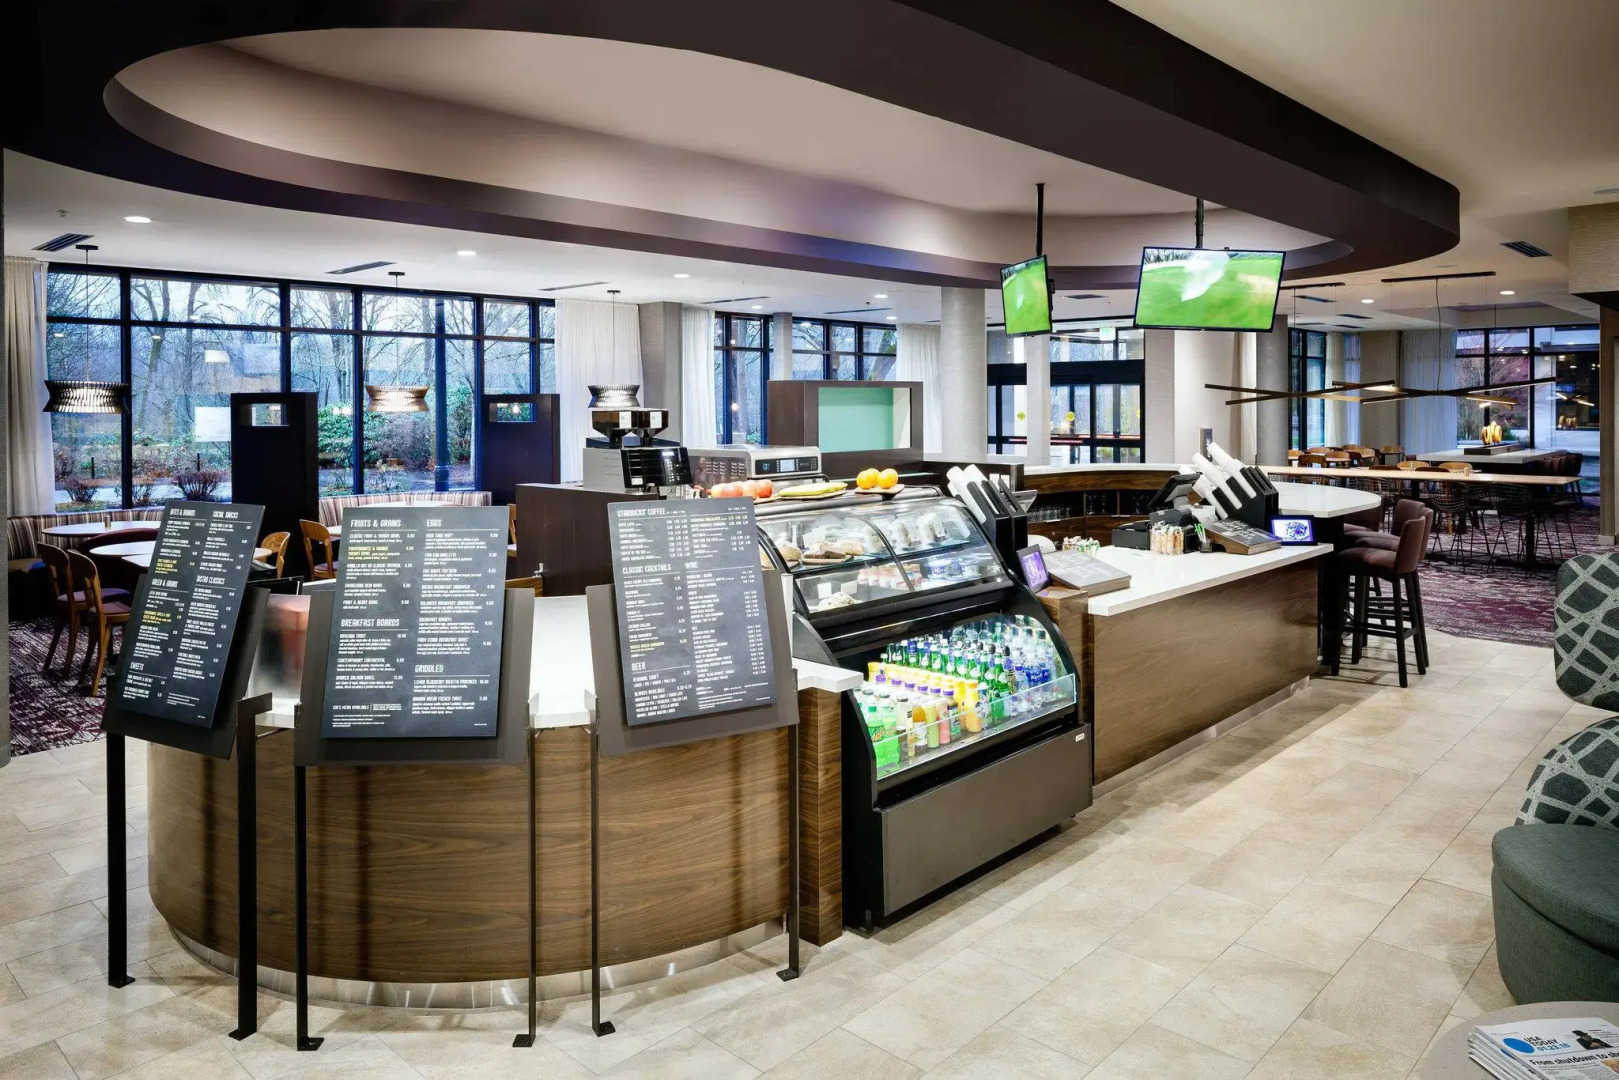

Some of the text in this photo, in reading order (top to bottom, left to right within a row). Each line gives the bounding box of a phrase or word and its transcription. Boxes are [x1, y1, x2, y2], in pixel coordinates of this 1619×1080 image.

[426, 519, 442, 527] EGGS
[622, 564, 672, 574] CLASSIC COCKTAILS
[341, 619, 400, 627] BREAKFAST BOARDS
[415, 664, 443, 673] GRIDDLED
[632, 662, 646, 671] BEER
[1531, 1039, 1558, 1047] TODAY
[1554, 1056, 1596, 1064] shutdown
